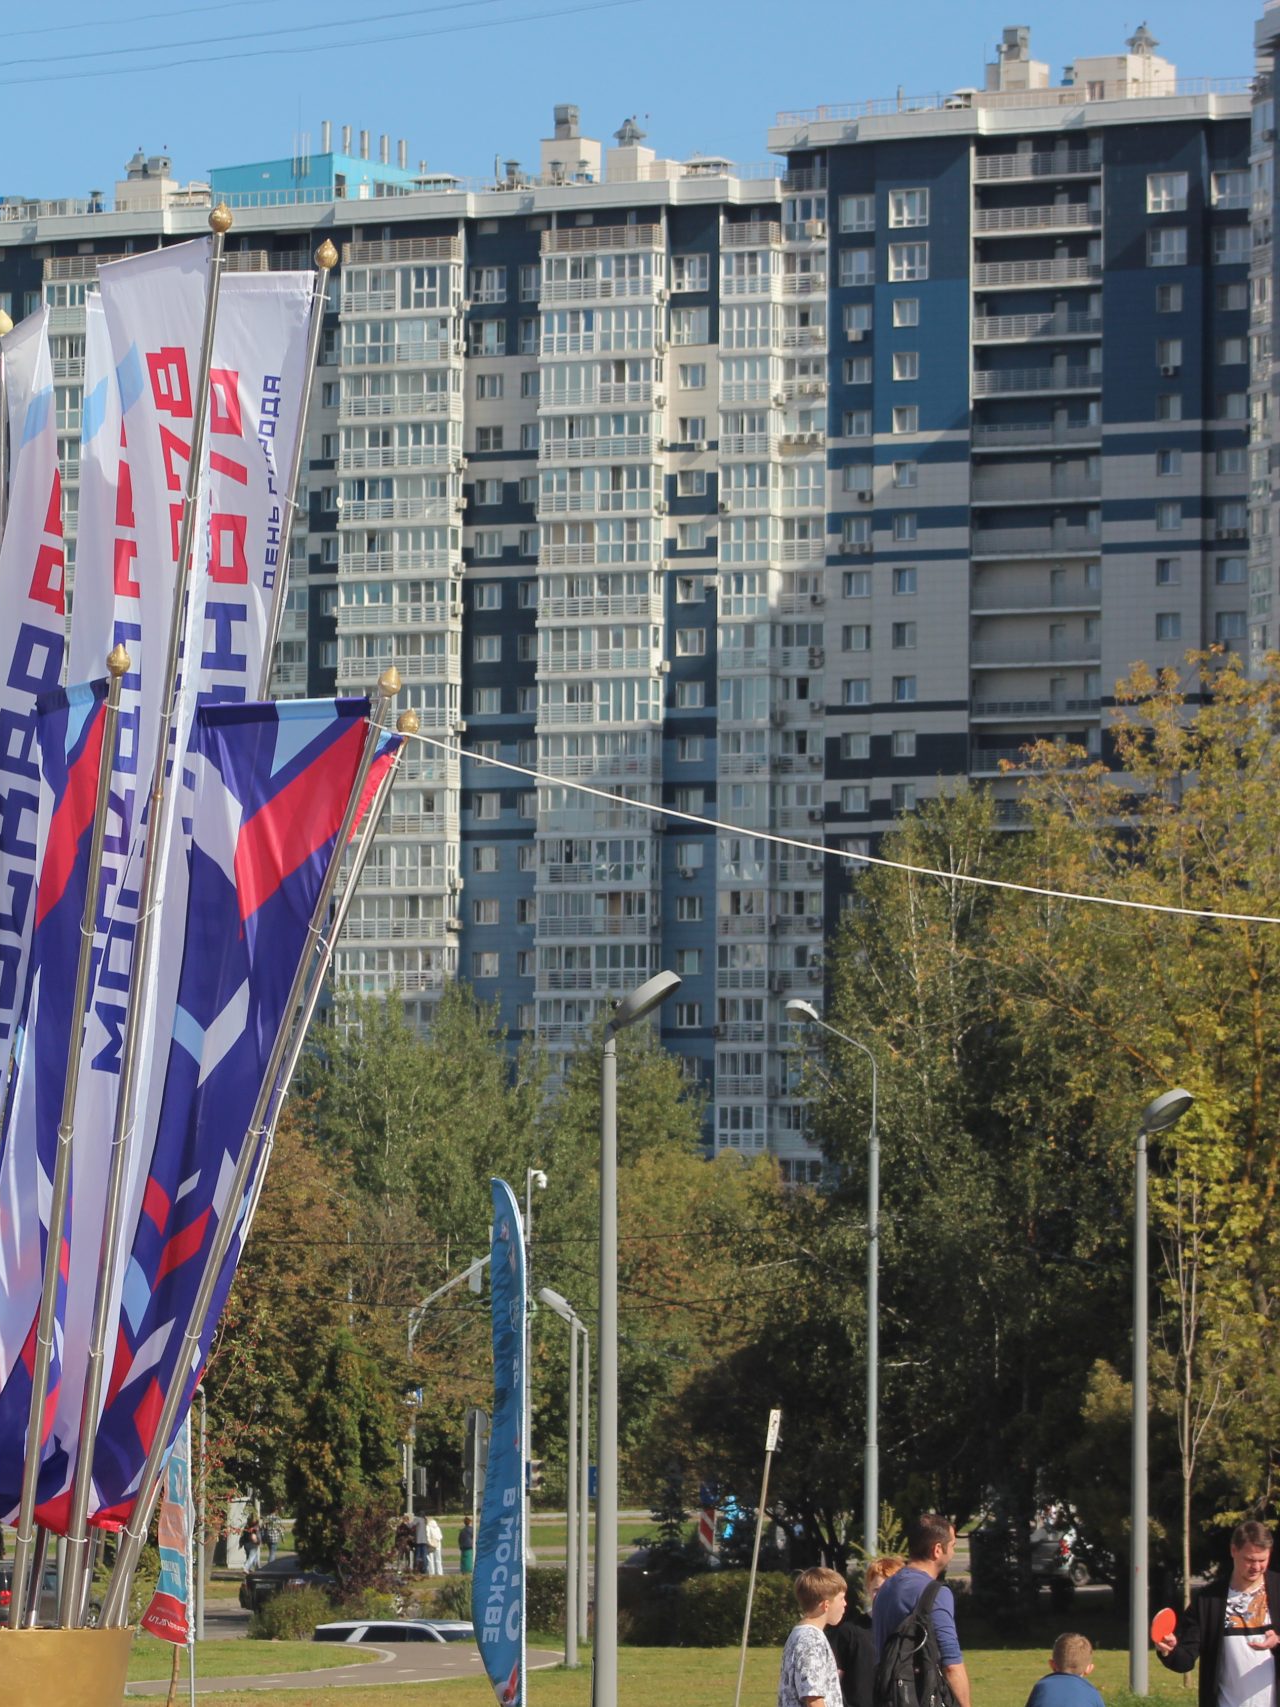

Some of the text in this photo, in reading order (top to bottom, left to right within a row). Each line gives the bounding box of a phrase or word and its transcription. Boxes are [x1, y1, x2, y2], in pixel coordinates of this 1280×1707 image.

[262, 506, 280, 590] ДЕНЬ
[502, 1487, 516, 1508] В
[482, 1516, 515, 1644] МОСКВЕ
